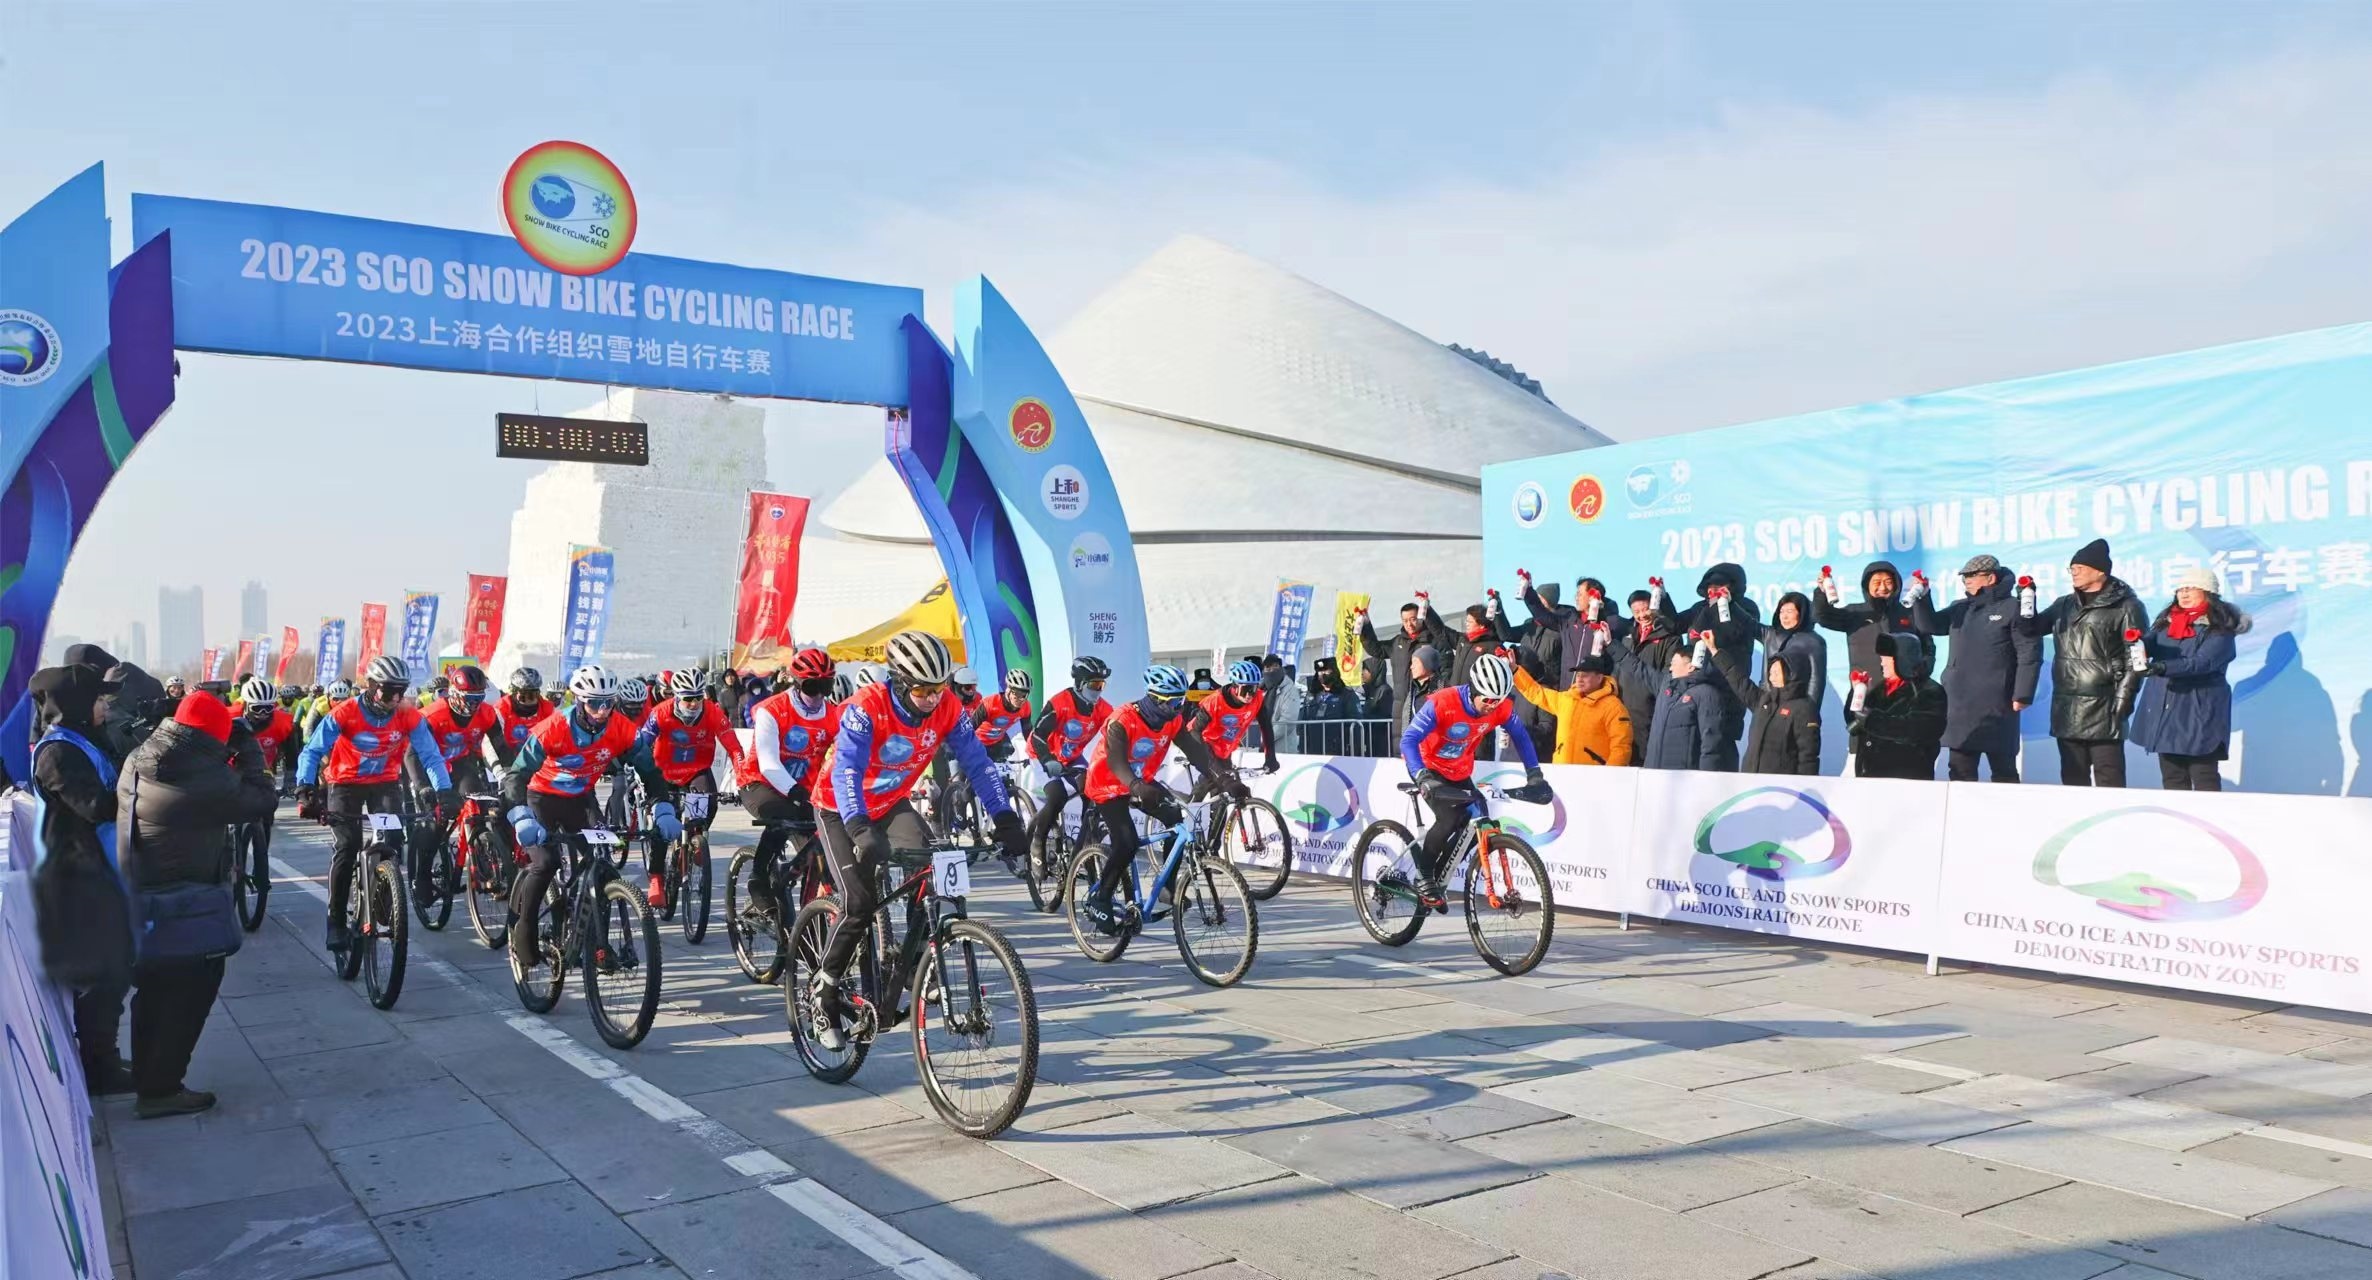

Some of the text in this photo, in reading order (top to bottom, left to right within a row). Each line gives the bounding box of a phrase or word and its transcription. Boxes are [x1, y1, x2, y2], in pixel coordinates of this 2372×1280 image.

[524, 214, 608, 250] SNOW BIKE CYCLING RACE
[589, 224, 610, 239] SCO
[240, 238, 855, 341] 2023 SCO SNOW BIKE CYCLING RACE
[336, 311, 771, 376] 2023上海合作组织雪地自行车赛
[1050, 495, 1080, 503] SHANGHE
[1661, 523, 1746, 569] 2023
[1754, 515, 1828, 563] SCO
[1838, 501, 1962, 558] SNOW
[1972, 487, 2081, 545] BIKE
[2092, 464, 2330, 537] CYCLING
[1089, 612, 1117, 621] SHENG
[1093, 622, 1115, 631] FANG
[379, 816, 388, 826] 7
[595, 832, 606, 841] 8
[947, 862, 958, 887] 9
[1559, 863, 1608, 880] SPORTS
[1646, 877, 1911, 917] CHINA SCO ICE AND SNOW SPORTS
[1680, 898, 1862, 933] DEMONSTRATION ZONE
[1963, 911, 2360, 975] CHINA SCO ICE AND SNOW SPORTS
[2014, 939, 2286, 991] DEMONSTRATION ZONE
